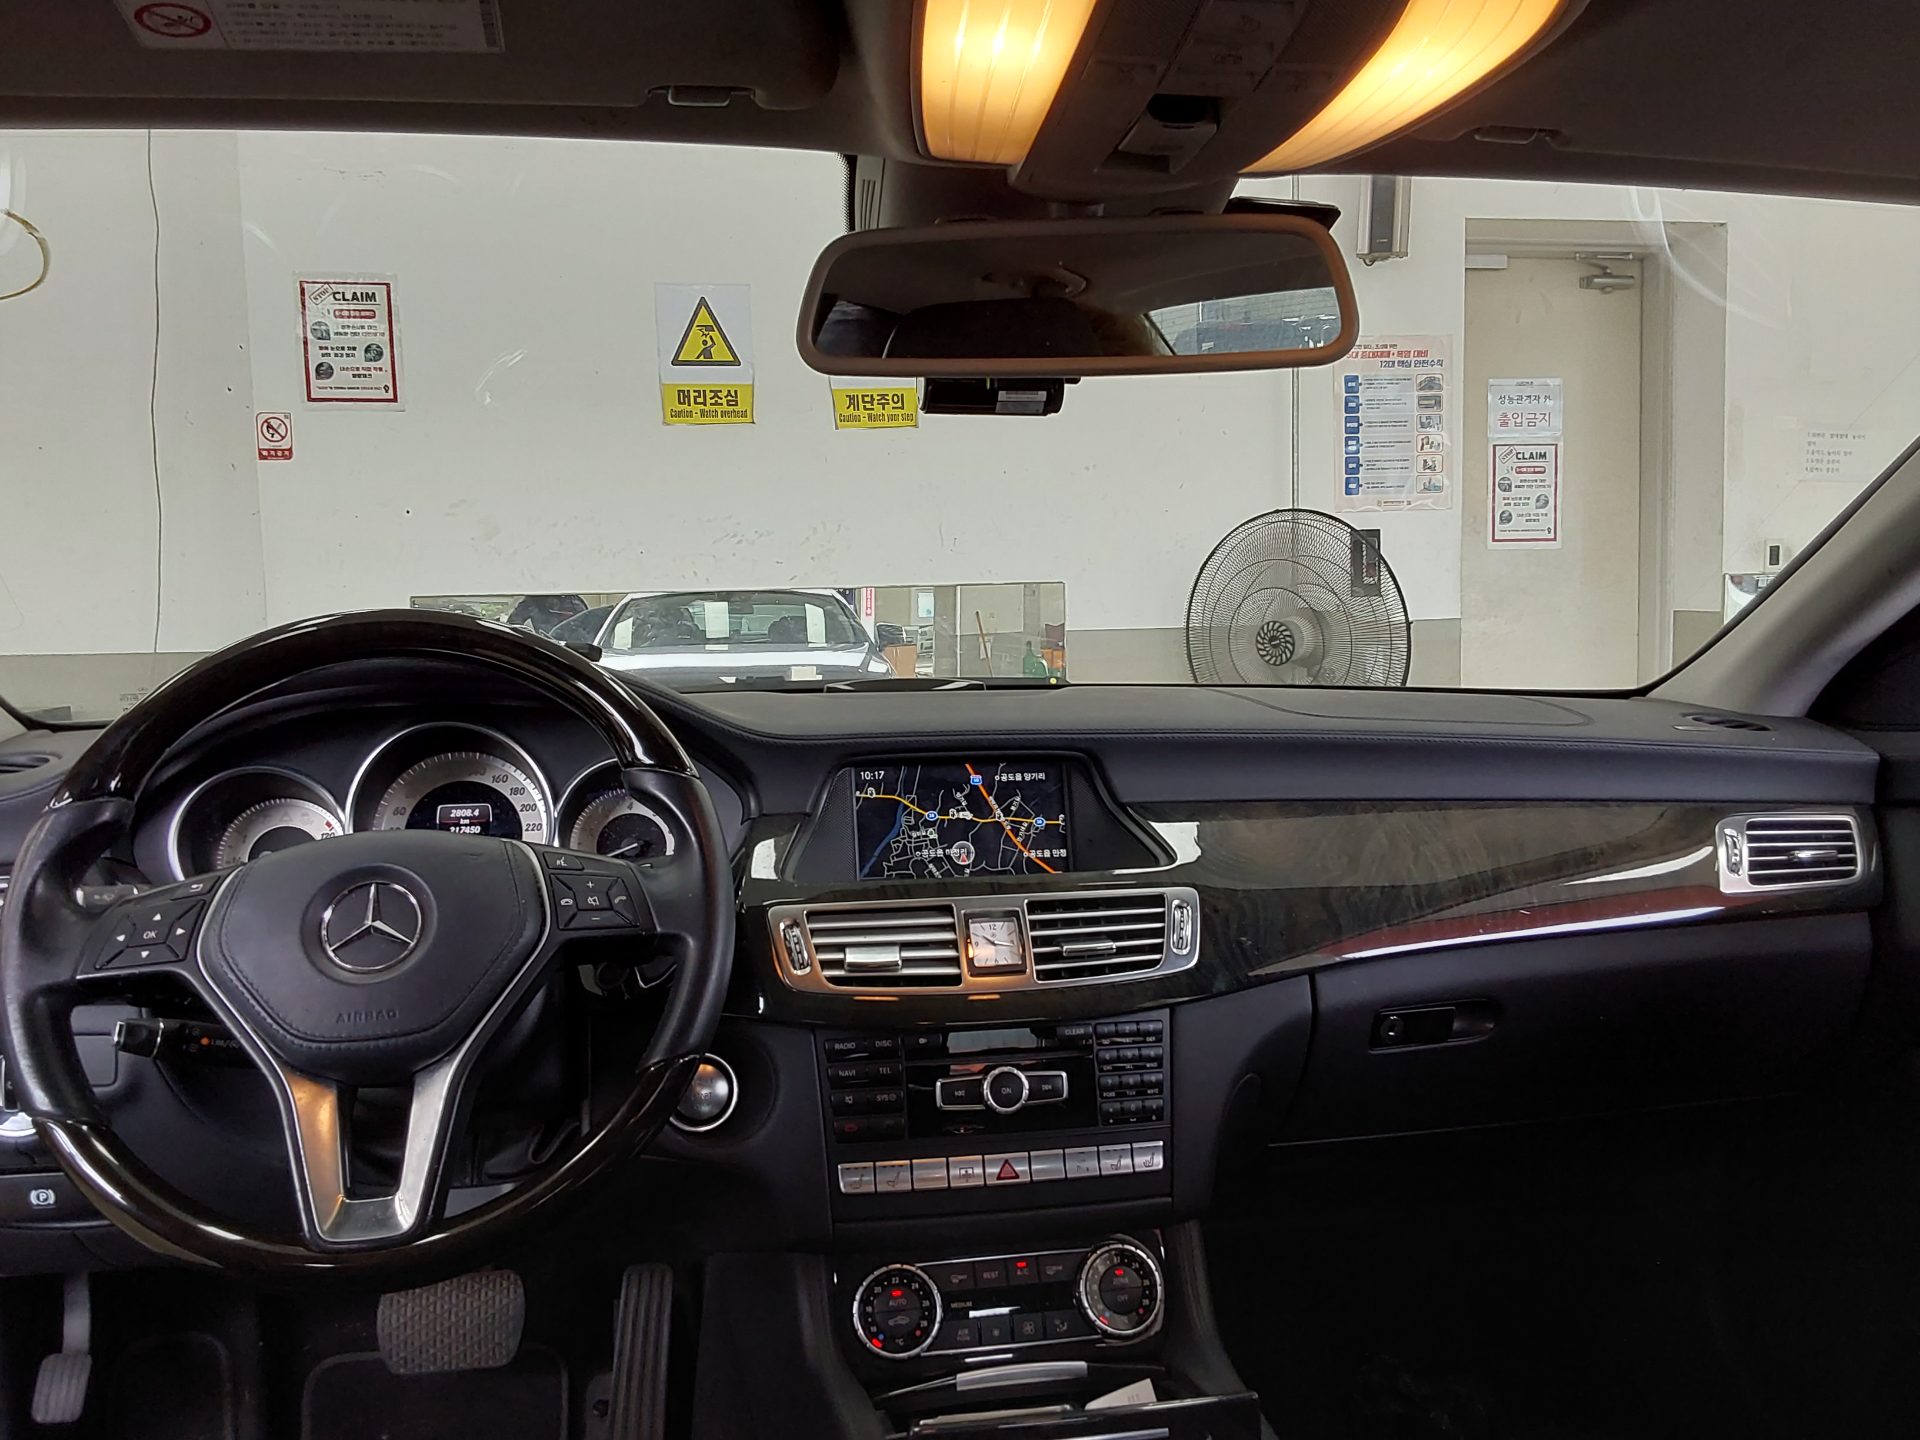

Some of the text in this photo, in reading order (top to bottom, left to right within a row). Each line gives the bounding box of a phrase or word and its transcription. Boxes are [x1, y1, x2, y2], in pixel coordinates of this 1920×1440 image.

[332, 291, 377, 302] CLAIM
[1379, 359, 1444, 369] 12대 핵심 안전수칙
[677, 389, 739, 407] 머리조심
[845, 393, 905, 412] 계단주의
[670, 408, 694, 419] Caution
[699, 408, 719, 419] Watch
[720, 408, 748, 419] overhead
[839, 412, 862, 423] Caution
[867, 412, 886, 423] Watch
[886, 412, 901, 423] your
[901, 412, 914, 422] step
[1497, 411, 1552, 428] 출입금지
[1515, 451, 1548, 461] CLAIM
[491, 774, 509, 784] 160
[860, 770, 885, 780] 10:17
[1000, 773, 1022, 781] 공도읍
[509, 786, 526, 796] 180
[450, 808, 480, 817] 2808.4
[519, 803, 538, 813] 200
[525, 823, 543, 832] 220
[988, 923, 997, 931] 12
[143, 930, 158, 940] OK
[834, 1040, 893, 1050] RADIO DISC
[839, 1069, 856, 1077] NAVI
[1001, 1087, 1012, 1095] ON
